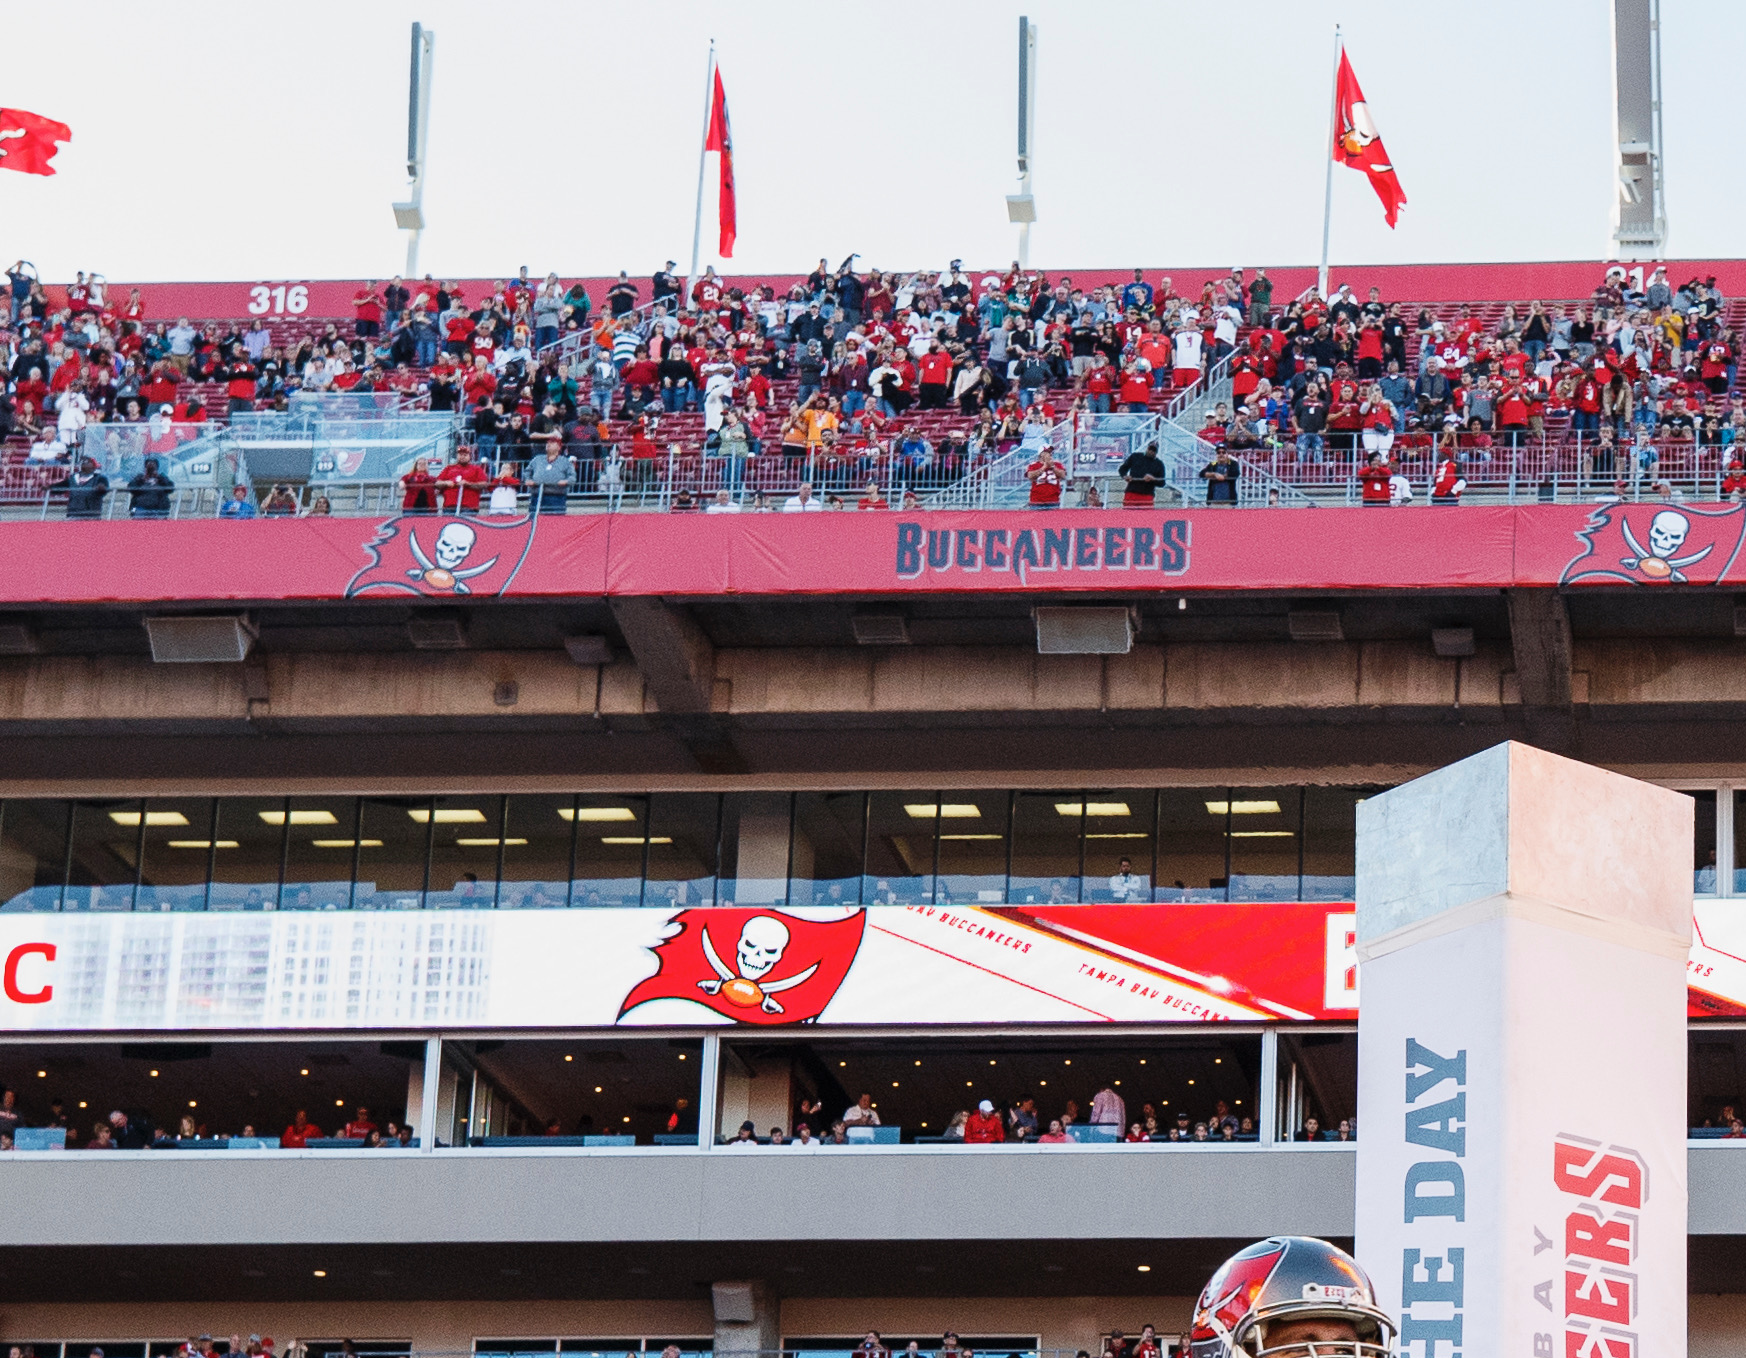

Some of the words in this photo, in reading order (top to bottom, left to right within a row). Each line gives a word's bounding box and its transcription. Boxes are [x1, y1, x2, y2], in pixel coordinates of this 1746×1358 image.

[248, 285, 310, 315] 316
[896, 519, 1193, 581] BUCCANEERS
[938, 911, 1033, 954] BUCCANEERS
[3, 942, 57, 1004] C
[1076, 962, 1125, 988] TAMPA
[1404, 1038, 1467, 1224] DAY
